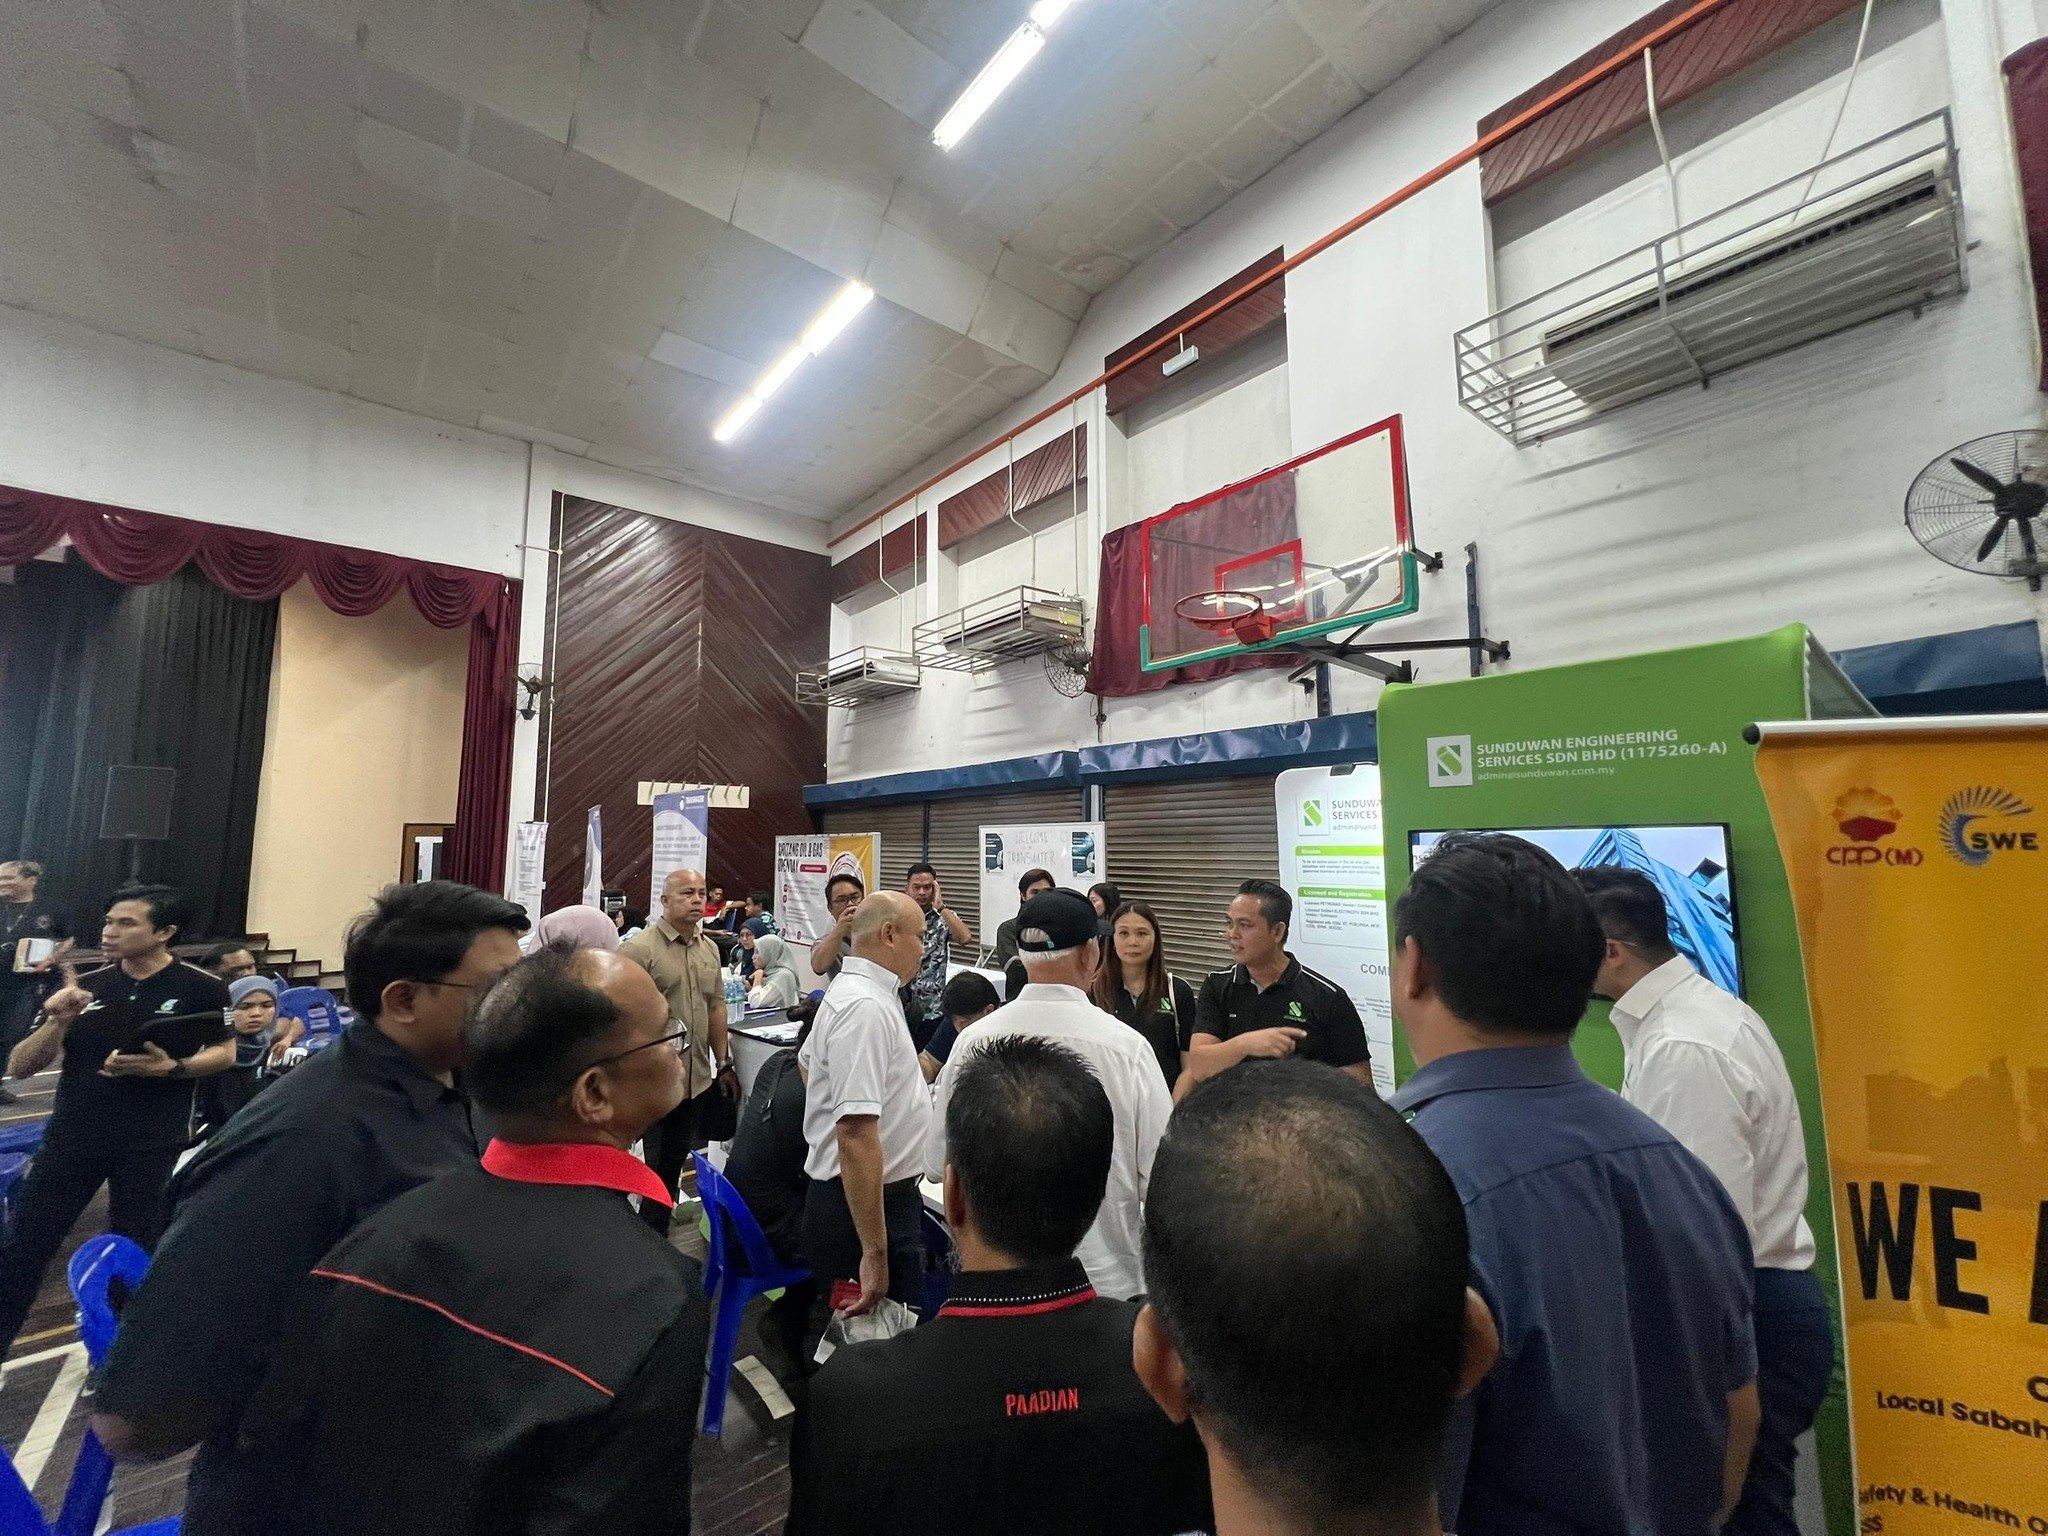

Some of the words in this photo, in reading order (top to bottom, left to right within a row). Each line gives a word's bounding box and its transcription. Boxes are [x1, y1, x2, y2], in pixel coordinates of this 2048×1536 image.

[1477, 738, 1562, 755] SUNDUWAN
[1566, 729, 1679, 749] ENGINEERING
[1477, 754, 1543, 768] SERVICES
[1546, 751, 1578, 764] SDN
[1582, 748, 1617, 763] BHD
[1621, 741, 1728, 761] (1175260-A)
[1477, 765, 1615, 781] admin@sunduwan.com.my
[1332, 810, 1378, 820] SERVICES
[1971, 832, 2039, 851] SWE
[1360, 963, 1388, 976] COM
[1846, 1181, 1990, 1315] WE
[1005, 1388, 1079, 1416] PAADIAN
[1876, 1390, 1945, 1417] Local
[1951, 1402, 2048, 1440] Sabah
[1911, 1487, 1929, 1505] &
[1934, 1491, 2020, 1528] Health
